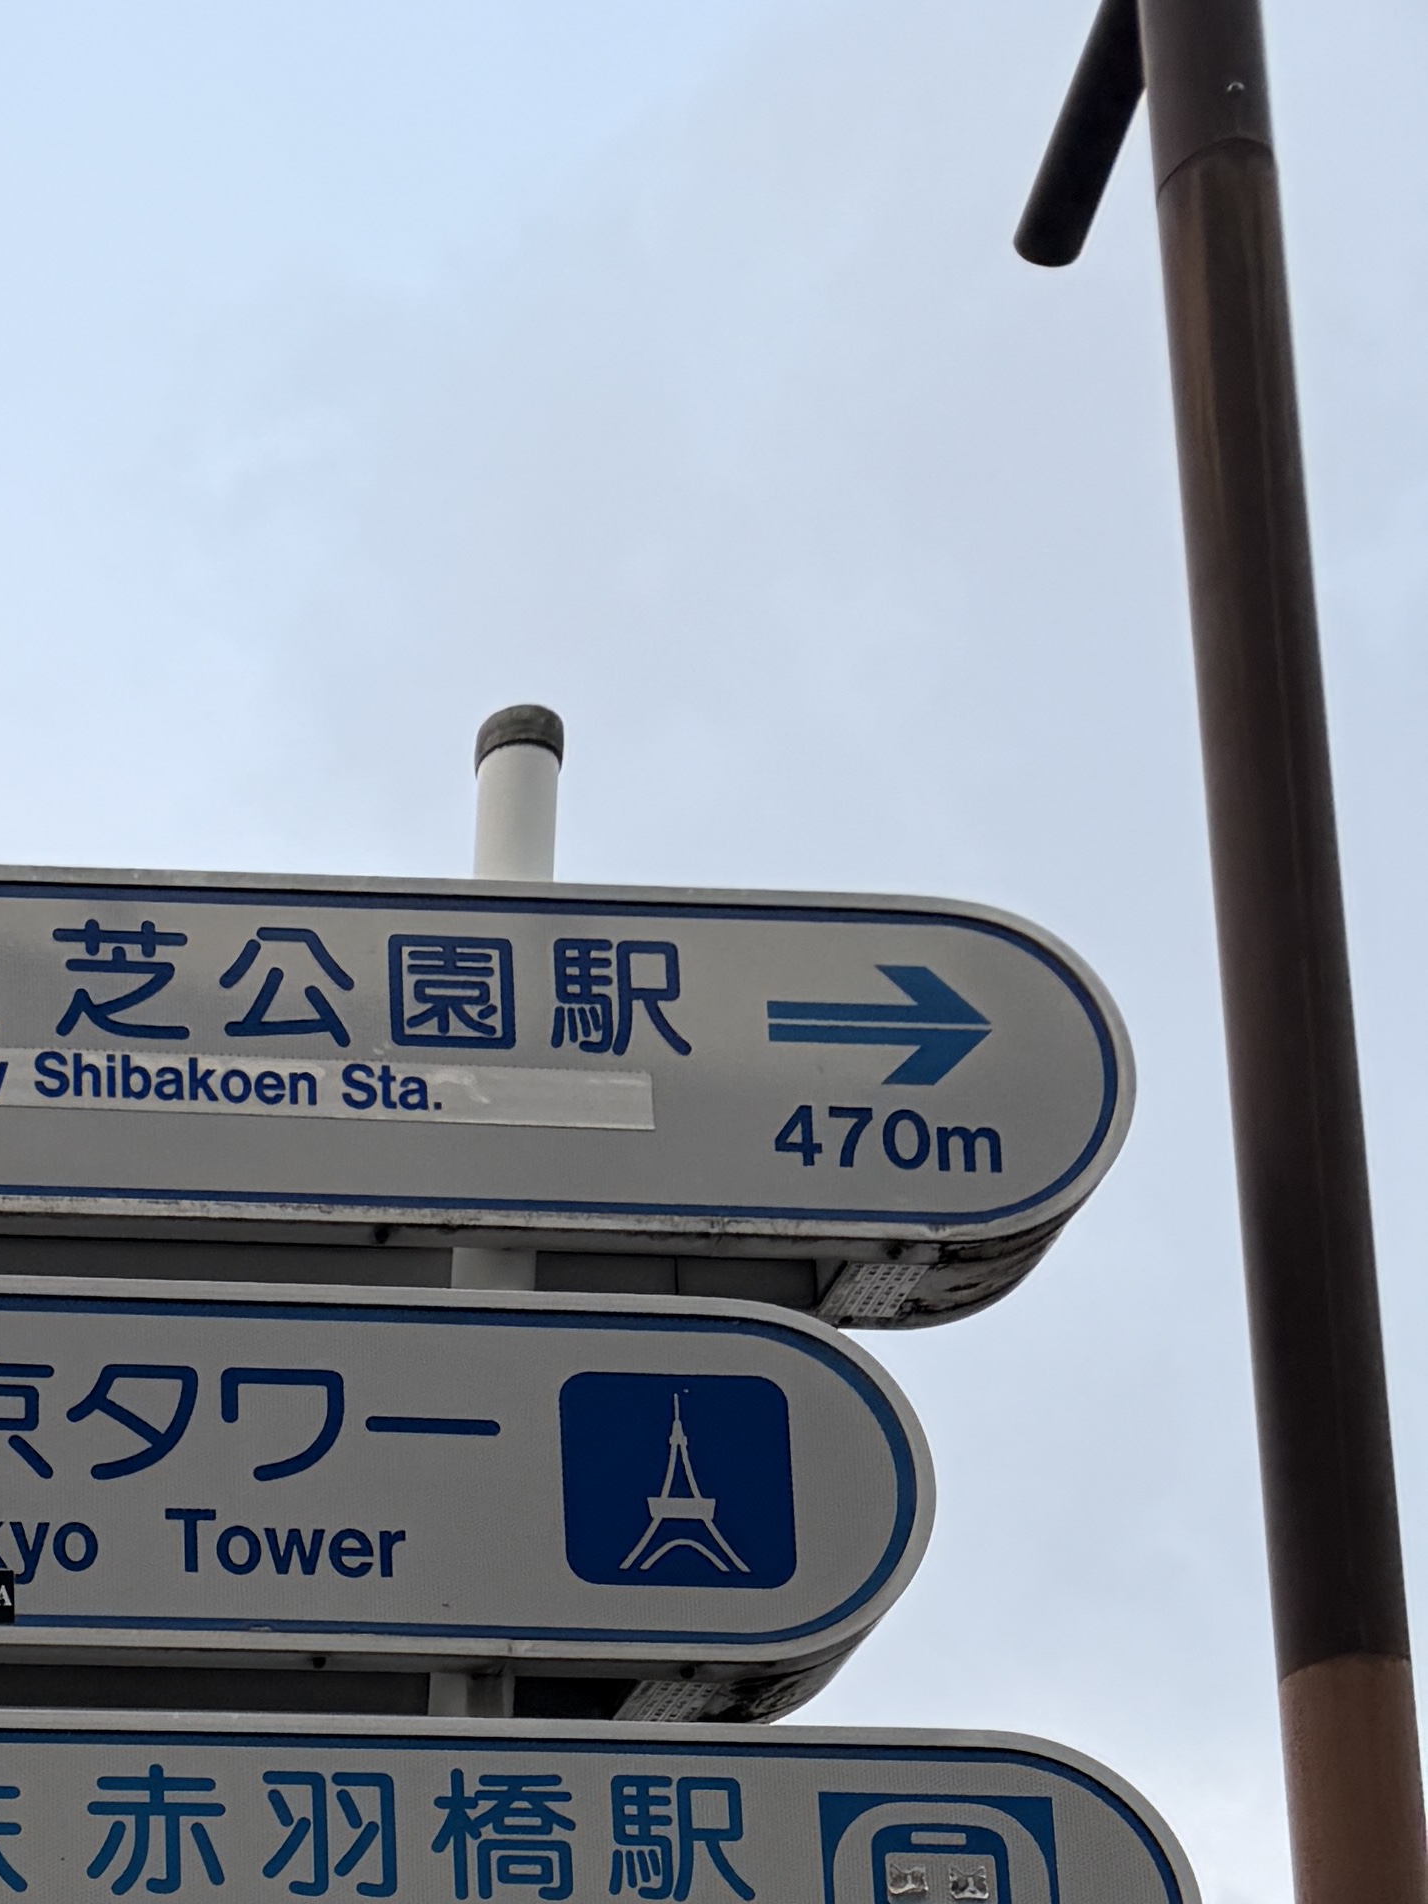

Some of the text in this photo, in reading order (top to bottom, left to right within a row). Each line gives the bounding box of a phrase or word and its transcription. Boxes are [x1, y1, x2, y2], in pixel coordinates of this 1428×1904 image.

[34, 1049, 317, 1108] Shibakoen
[342, 1064, 443, 1112] Sta.
[775, 1105, 1002, 1173] 470m
[165, 1508, 405, 1578] Tower
